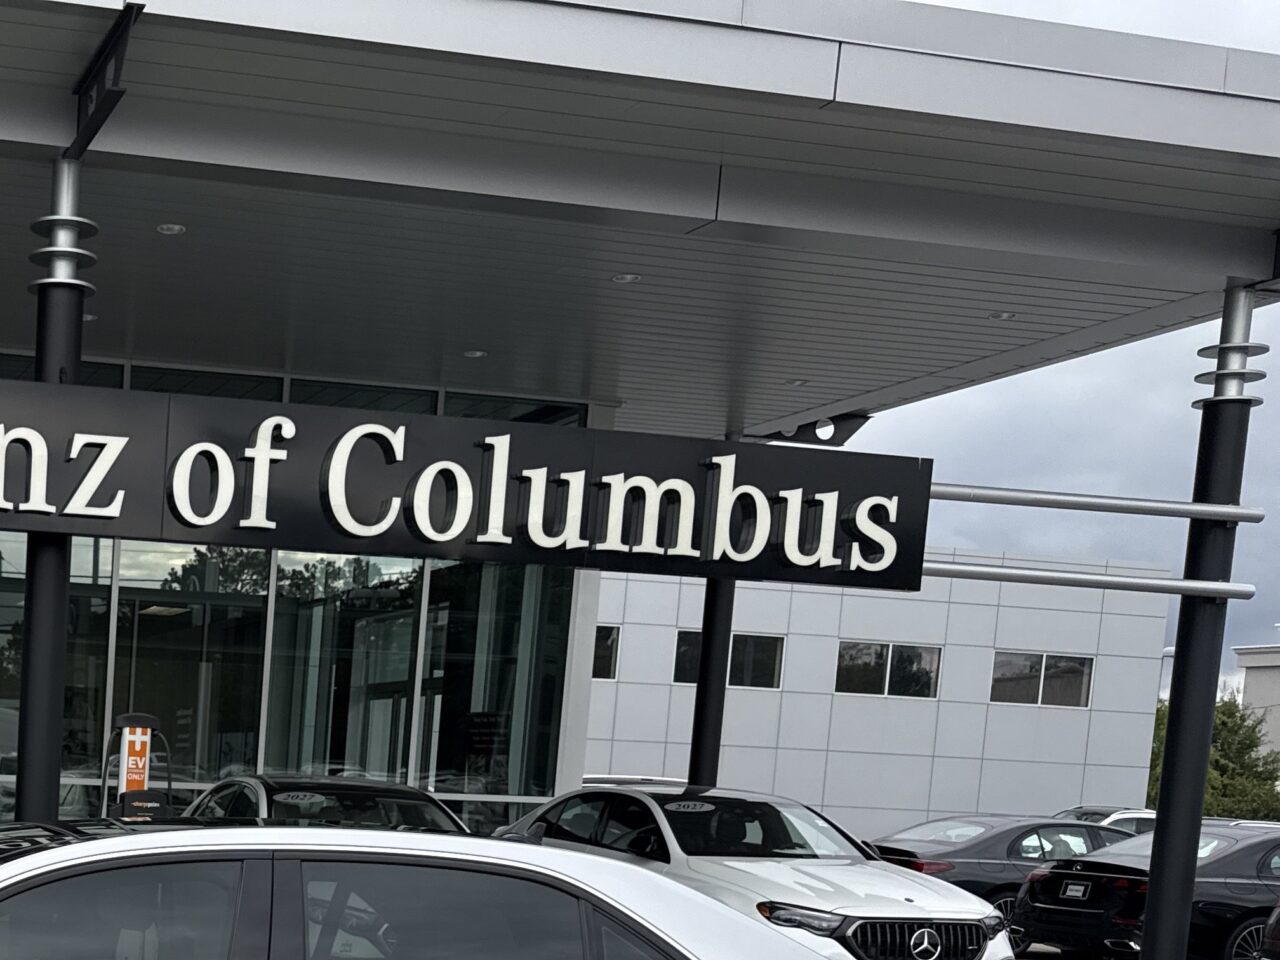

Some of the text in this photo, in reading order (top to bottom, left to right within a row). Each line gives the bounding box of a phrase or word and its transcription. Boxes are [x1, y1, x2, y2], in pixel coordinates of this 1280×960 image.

[172, 416, 297, 530] of
[328, 423, 900, 573] Columbus
[128, 756, 146, 769] EV
